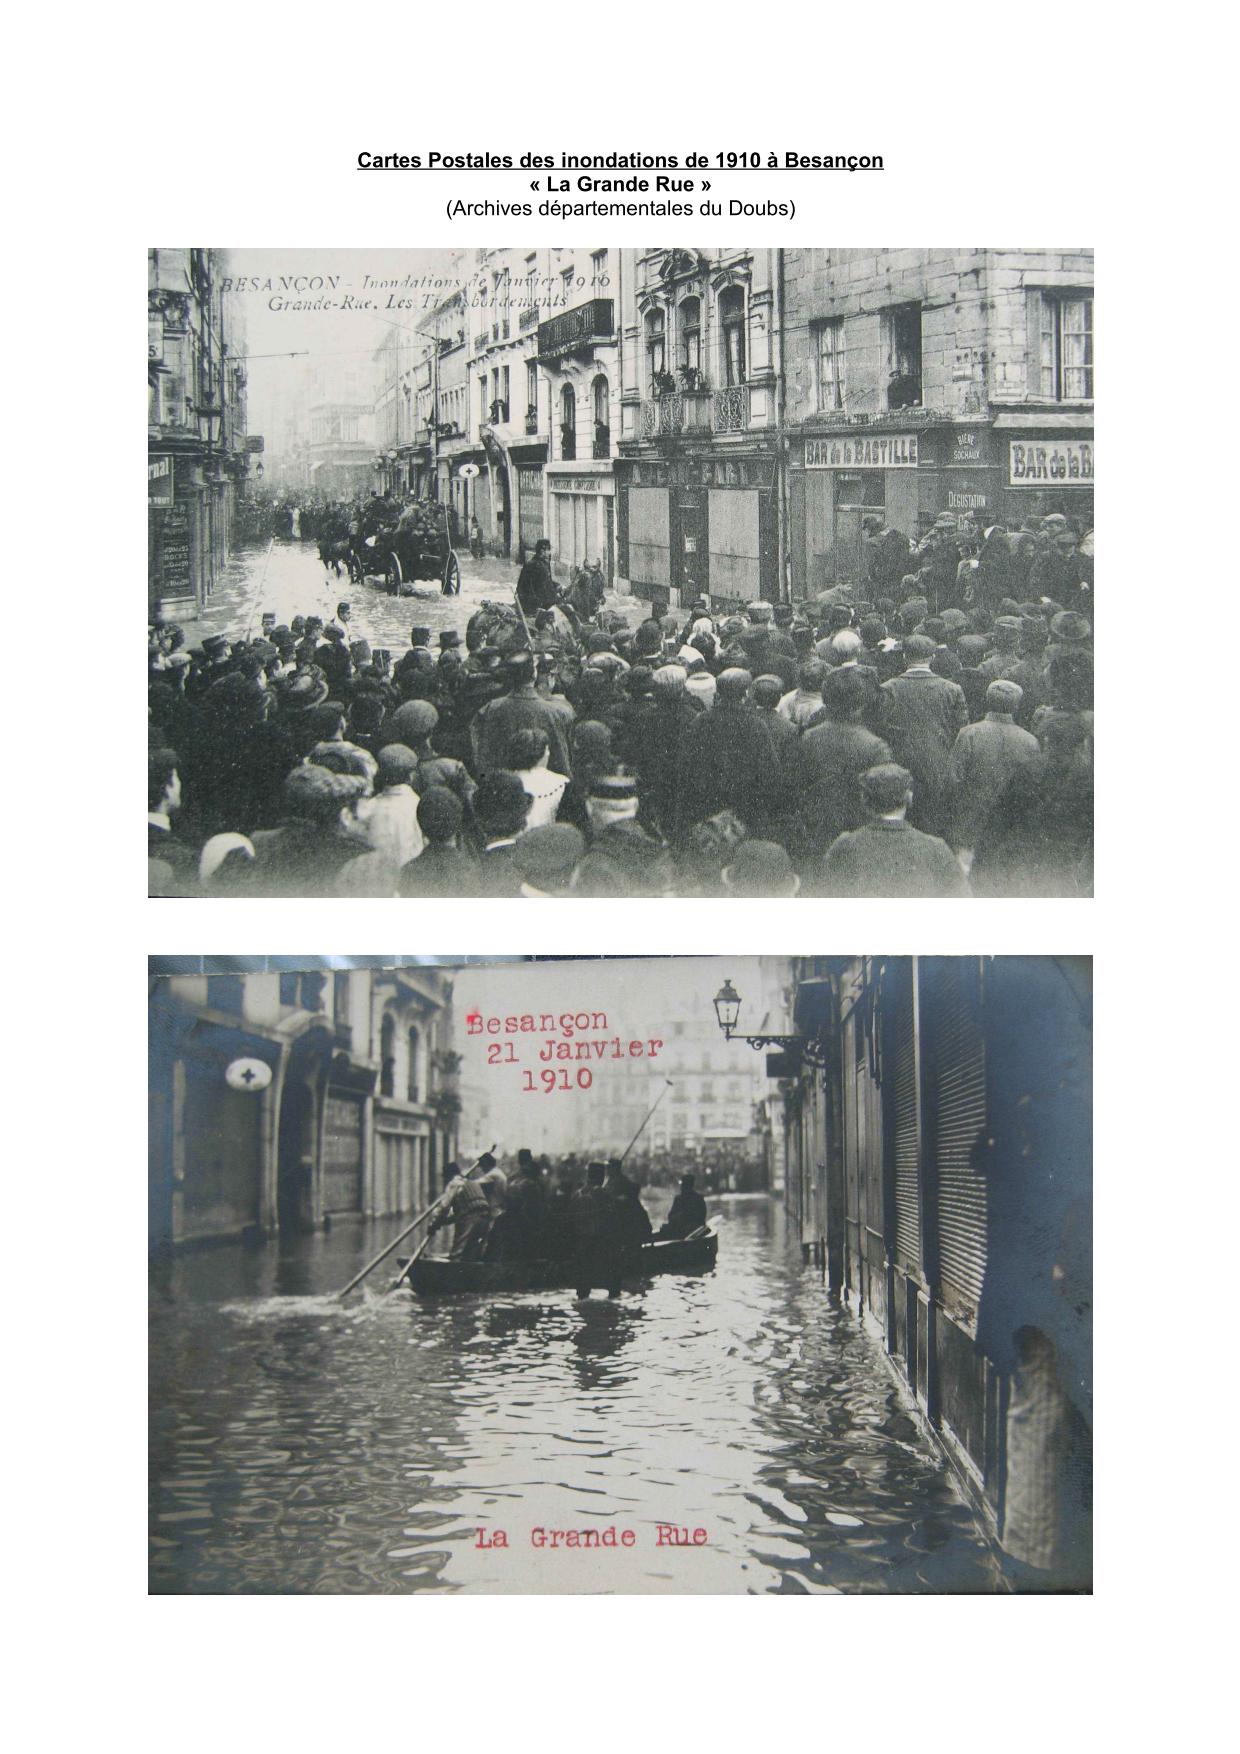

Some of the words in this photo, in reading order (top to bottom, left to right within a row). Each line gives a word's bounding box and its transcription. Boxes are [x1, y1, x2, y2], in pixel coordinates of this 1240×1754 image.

[357, 151, 421, 167] Cartes
[428, 151, 512, 167] Postales
[519, 151, 554, 167] des
[561, 151, 678, 167] inondations
[685, 151, 708, 167] de
[715, 151, 760, 167] 1910
[767, 151, 778, 167] à
[785, 151, 883, 170] Besançon
[547, 175, 570, 191] La
[577, 175, 649, 191] Grande
[656, 175, 694, 191] Rue
[446, 199, 532, 220] (Archives
[538, 199, 693, 220] départementales
[699, 199, 721, 215] du
[729, 199, 795, 220] Doubs)
[806, 440, 828, 465] BAR
[853, 438, 917, 465] BASTILLE
[1012, 444, 1048, 479] BAR
[1050, 449, 1067, 479] de
[1067, 448, 1080, 479] la
[1079, 444, 1094, 479] B
